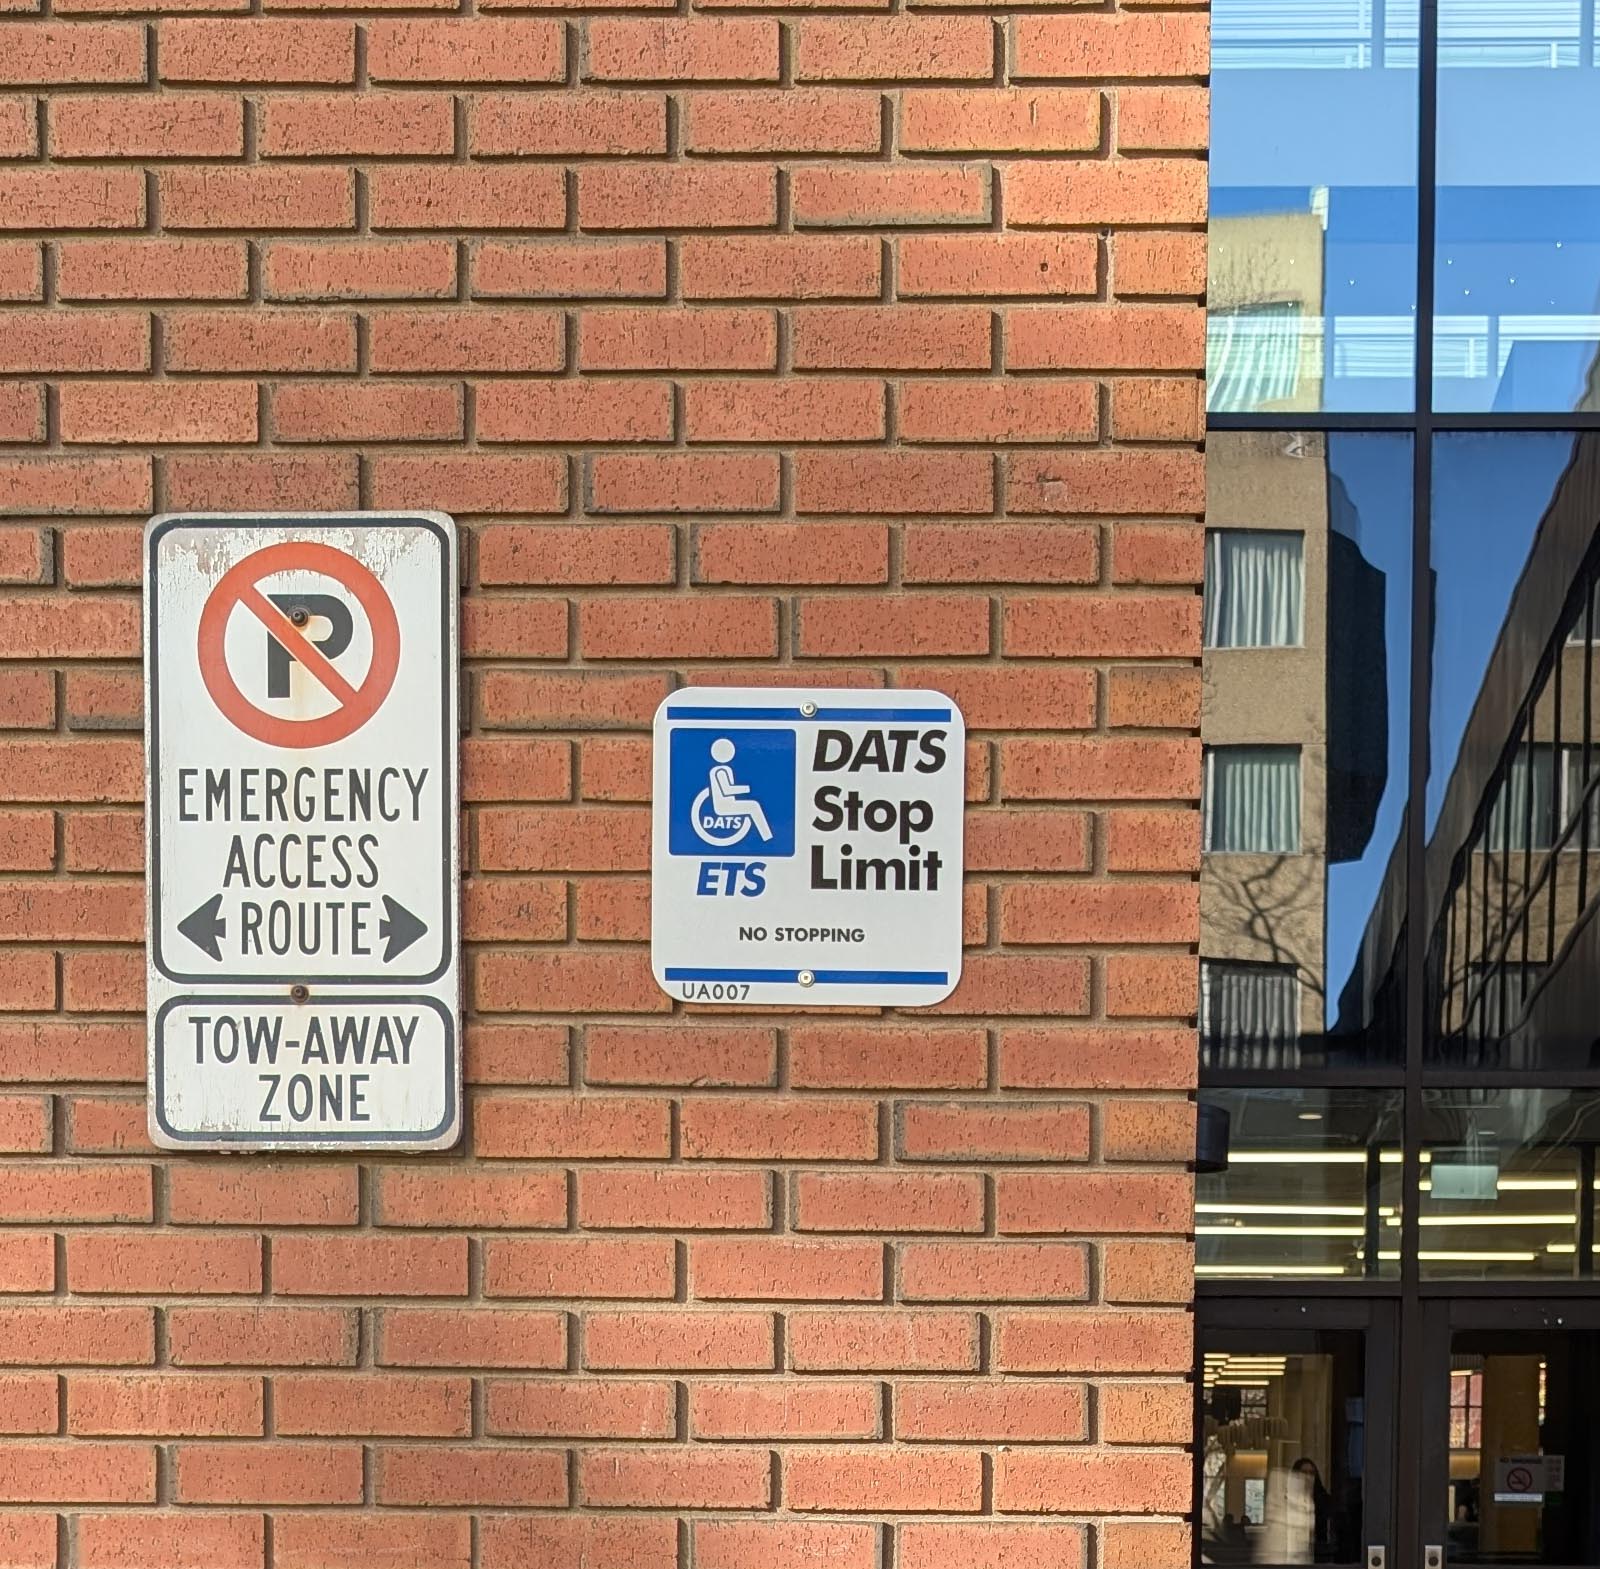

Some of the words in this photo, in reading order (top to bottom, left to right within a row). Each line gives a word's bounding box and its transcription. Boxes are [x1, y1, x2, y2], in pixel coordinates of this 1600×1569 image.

[267, 594, 353, 698] P
[812, 729, 948, 774] DATS
[178, 766, 429, 822] EMERGENCY
[811, 785, 934, 845] Stop
[703, 816, 743, 830] DATS
[222, 834, 379, 889] ACCESS
[696, 861, 767, 897] ETS
[810, 844, 943, 891] Limit
[241, 900, 371, 956] ROUTE
[738, 926, 768, 942] NO
[774, 926, 866, 943] STOPPING
[682, 984, 751, 1001] UA007
[188, 1015, 420, 1065] TOW-AWAY
[258, 1074, 371, 1122] ZONE
